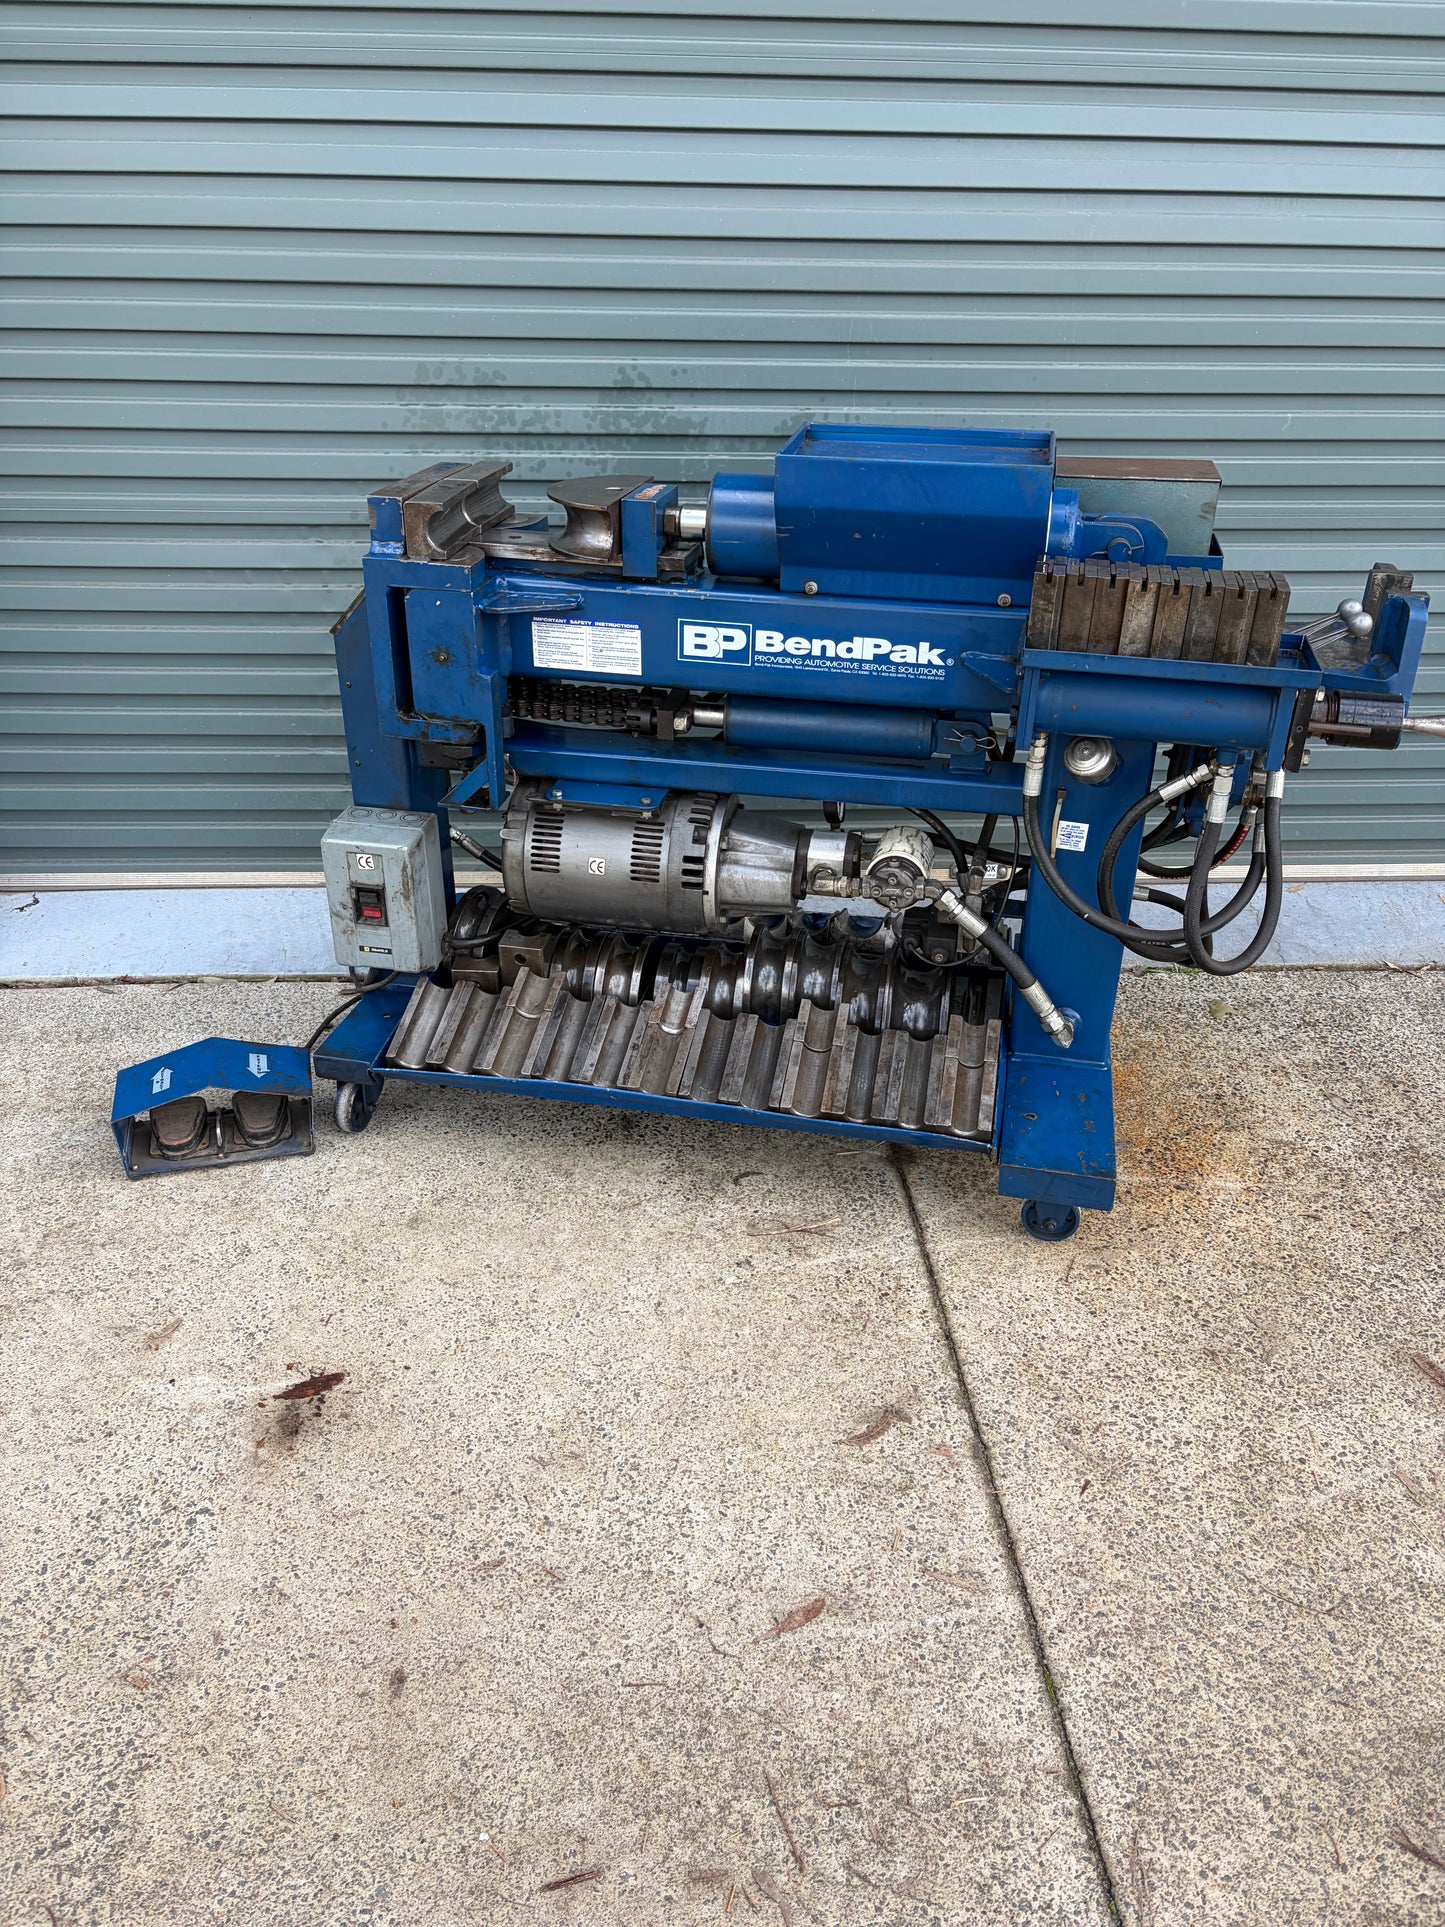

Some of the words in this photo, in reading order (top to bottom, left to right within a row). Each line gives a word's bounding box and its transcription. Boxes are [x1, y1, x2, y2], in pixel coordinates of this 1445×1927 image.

[532, 616, 567, 624] IMPORTANT
[594, 621, 640, 630] INSTRUCTIONS
[683, 624, 747, 659] BP
[755, 629, 946, 666] BendPak
[754, 654, 802, 665] PROVIDING
[803, 658, 860, 670] AUTOMOTIVE
[861, 663, 897, 673] SERVICE
[898, 666, 946, 676] SOLUTIONS
[358, 855, 373, 869] CE
[589, 859, 604, 874] CE
